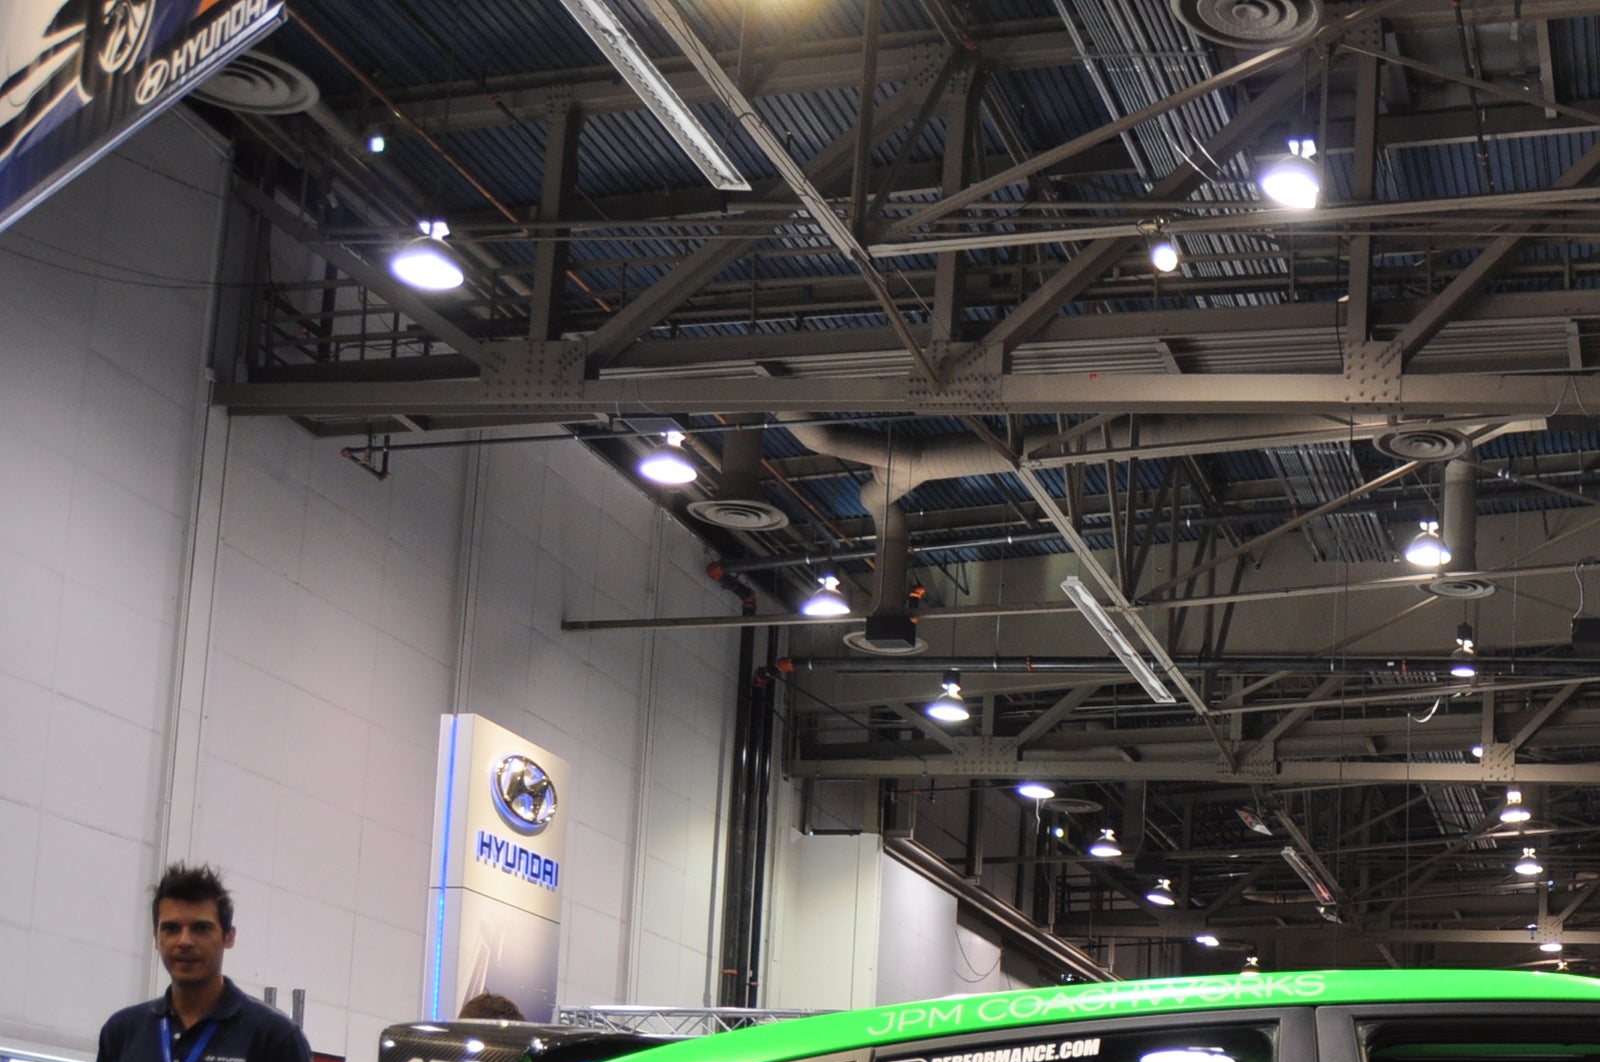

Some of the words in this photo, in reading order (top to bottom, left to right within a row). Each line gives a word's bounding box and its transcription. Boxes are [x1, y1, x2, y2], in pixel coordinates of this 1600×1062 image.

[476, 830, 559, 888] HYUNDAI
[868, 1002, 962, 1035] JPM
[977, 973, 1326, 1022] COACHWORKS
